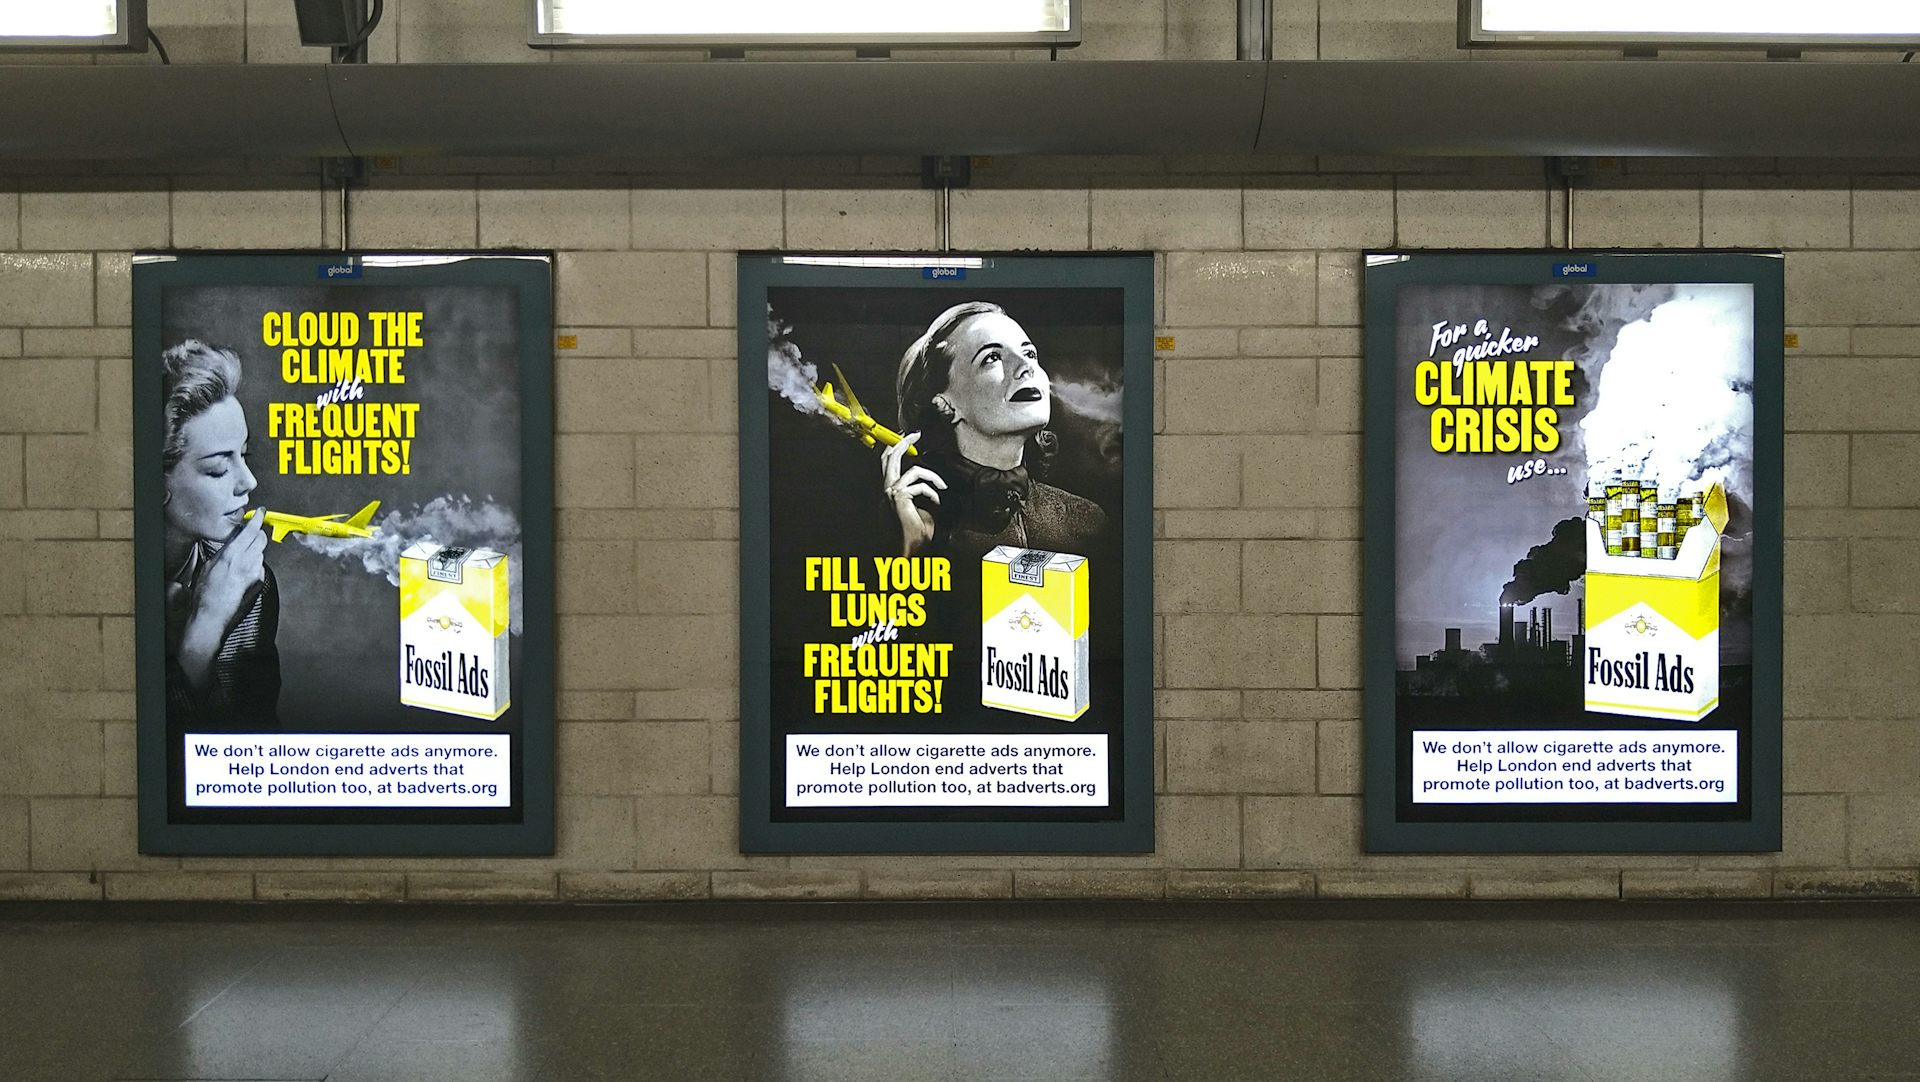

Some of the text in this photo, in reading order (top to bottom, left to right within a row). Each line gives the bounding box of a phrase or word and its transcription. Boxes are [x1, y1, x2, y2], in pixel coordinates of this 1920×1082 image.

[327, 265, 353, 277] global
[932, 267, 957, 278] global
[1562, 264, 1588, 275] global
[263, 312, 423, 347] CLOUD THE
[1429, 319, 1488, 357] For a
[282, 349, 405, 384] CLIMATE
[1453, 327, 1539, 378] quicker
[316, 375, 364, 411] with
[1415, 360, 1575, 406] CLIMATE
[268, 403, 420, 438] FREQUENT
[1430, 407, 1560, 453] CRISIS
[279, 440, 410, 475] FLIGHTS!
[1507, 458, 1567, 484] use...
[806, 556, 952, 592] FILL YOUR
[1014, 573, 1038, 581] FINEST
[830, 593, 927, 628] LUNGS
[851, 617, 899, 651] with
[405, 643, 489, 699] Fossil Ads
[803, 642, 953, 678] FREQUENT
[986, 646, 1069, 700] Fossil Ads
[1588, 646, 1694, 695] Fossil Ads
[814, 679, 943, 714] FLIGHTS!
[194, 744, 498, 759] We don't allow cigarette ads anymore.
[795, 744, 1096, 759] We don't allow cigarette ads anymore.
[1422, 740, 1725, 756] We don't allow cigarette ads anymore.
[228, 762, 464, 778] Help London end adverts that
[830, 762, 1064, 777] Help London end adverts that
[1457, 758, 1692, 774] Help London end adverts that
[196, 780, 497, 796] promote pollution too, at badverts.org
[796, 780, 1096, 796] promote pollution too, at badverts.org
[1423, 776, 1725, 792] promote pollution too, at badverts.org
